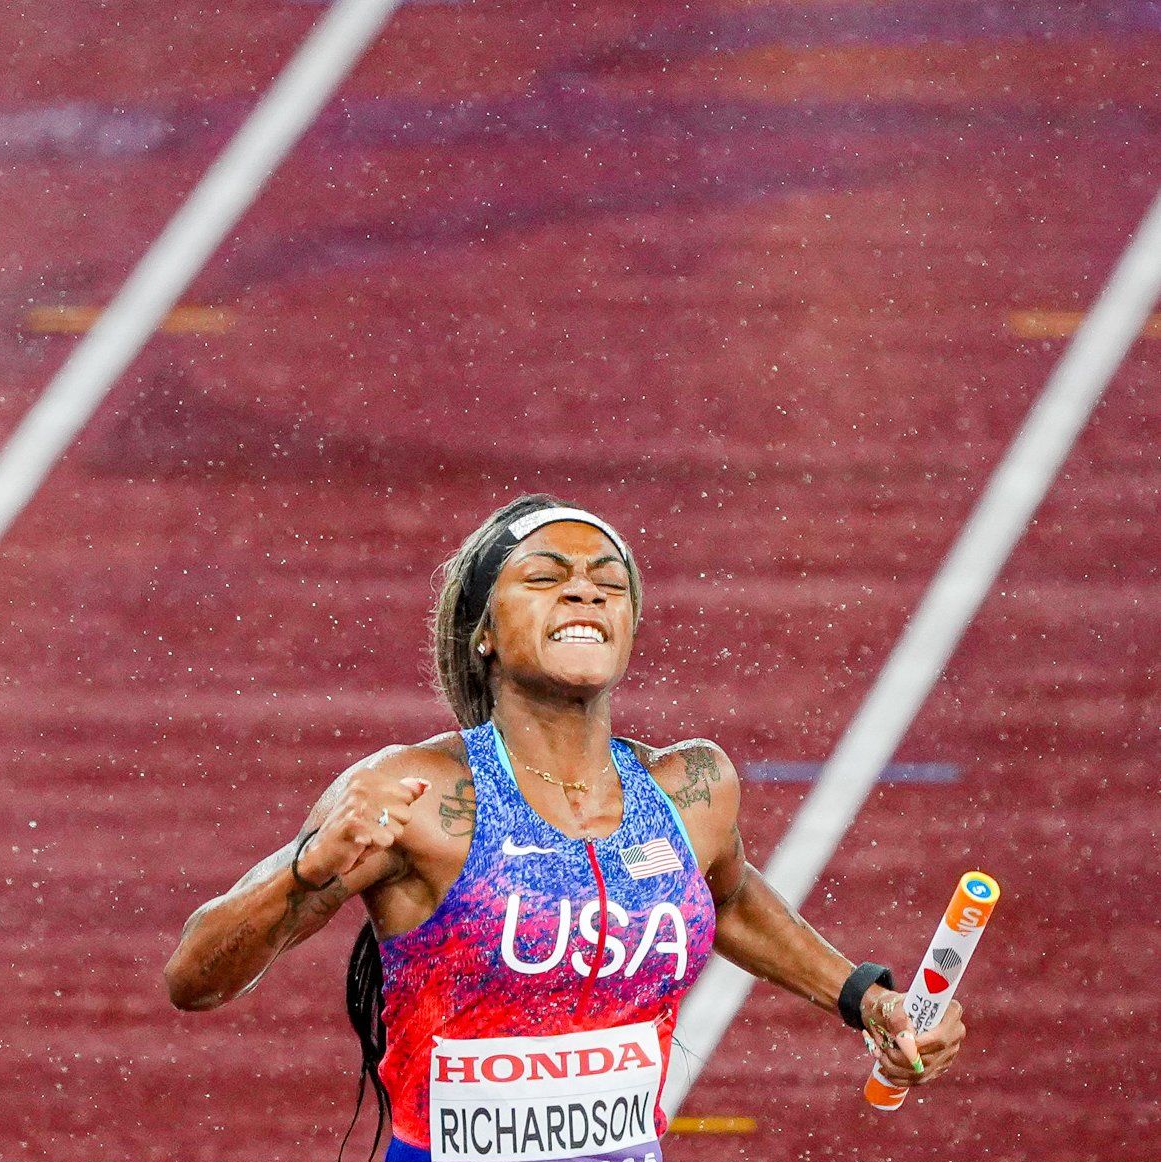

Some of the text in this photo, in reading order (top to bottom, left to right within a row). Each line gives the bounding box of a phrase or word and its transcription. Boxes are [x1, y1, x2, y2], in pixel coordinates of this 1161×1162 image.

[501, 894, 688, 980] USA
[434, 1041, 657, 1084] HONDA
[440, 1091, 651, 1155] RICHARDSON
